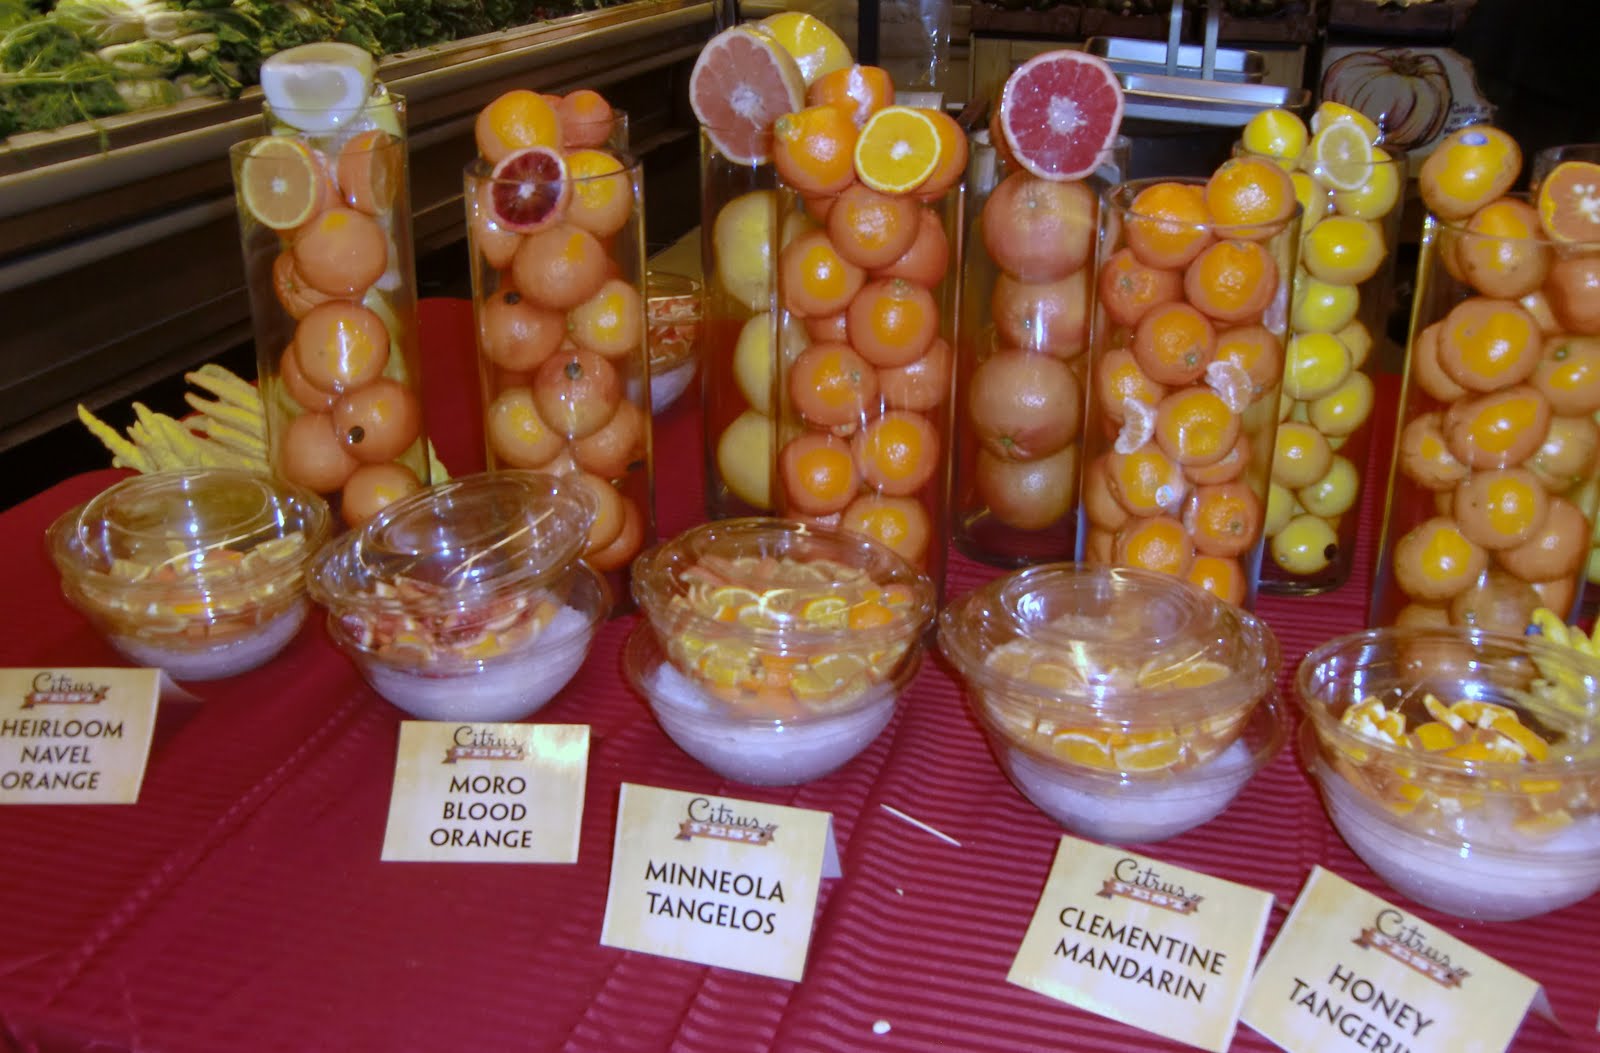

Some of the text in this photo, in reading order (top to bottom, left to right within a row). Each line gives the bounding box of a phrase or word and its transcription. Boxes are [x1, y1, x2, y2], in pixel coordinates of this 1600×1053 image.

[32, 672, 94, 694] Citrus
[1, 719, 124, 739] HEIRLOOM
[453, 725, 517, 748] Citrus
[20, 746, 92, 764] NAVEL
[0, 771, 101, 790] ORANGE
[449, 775, 527, 795] MORO
[442, 802, 527, 821] BLOOD
[687, 797, 761, 830] Citrus
[430, 828, 533, 849] ORANGE
[644, 859, 786, 904] MINNEOLA
[1113, 857, 1187, 898] Citrus
[646, 891, 777, 935] TANGELOS
[1059, 906, 1227, 976] CLEMENTINE
[1375, 908, 1452, 969] Citrus
[1054, 937, 1207, 1004] MANDARIN
[1288, 977, 1413, 1053] TANGERI
[1328, 963, 1435, 1037] HONEY
